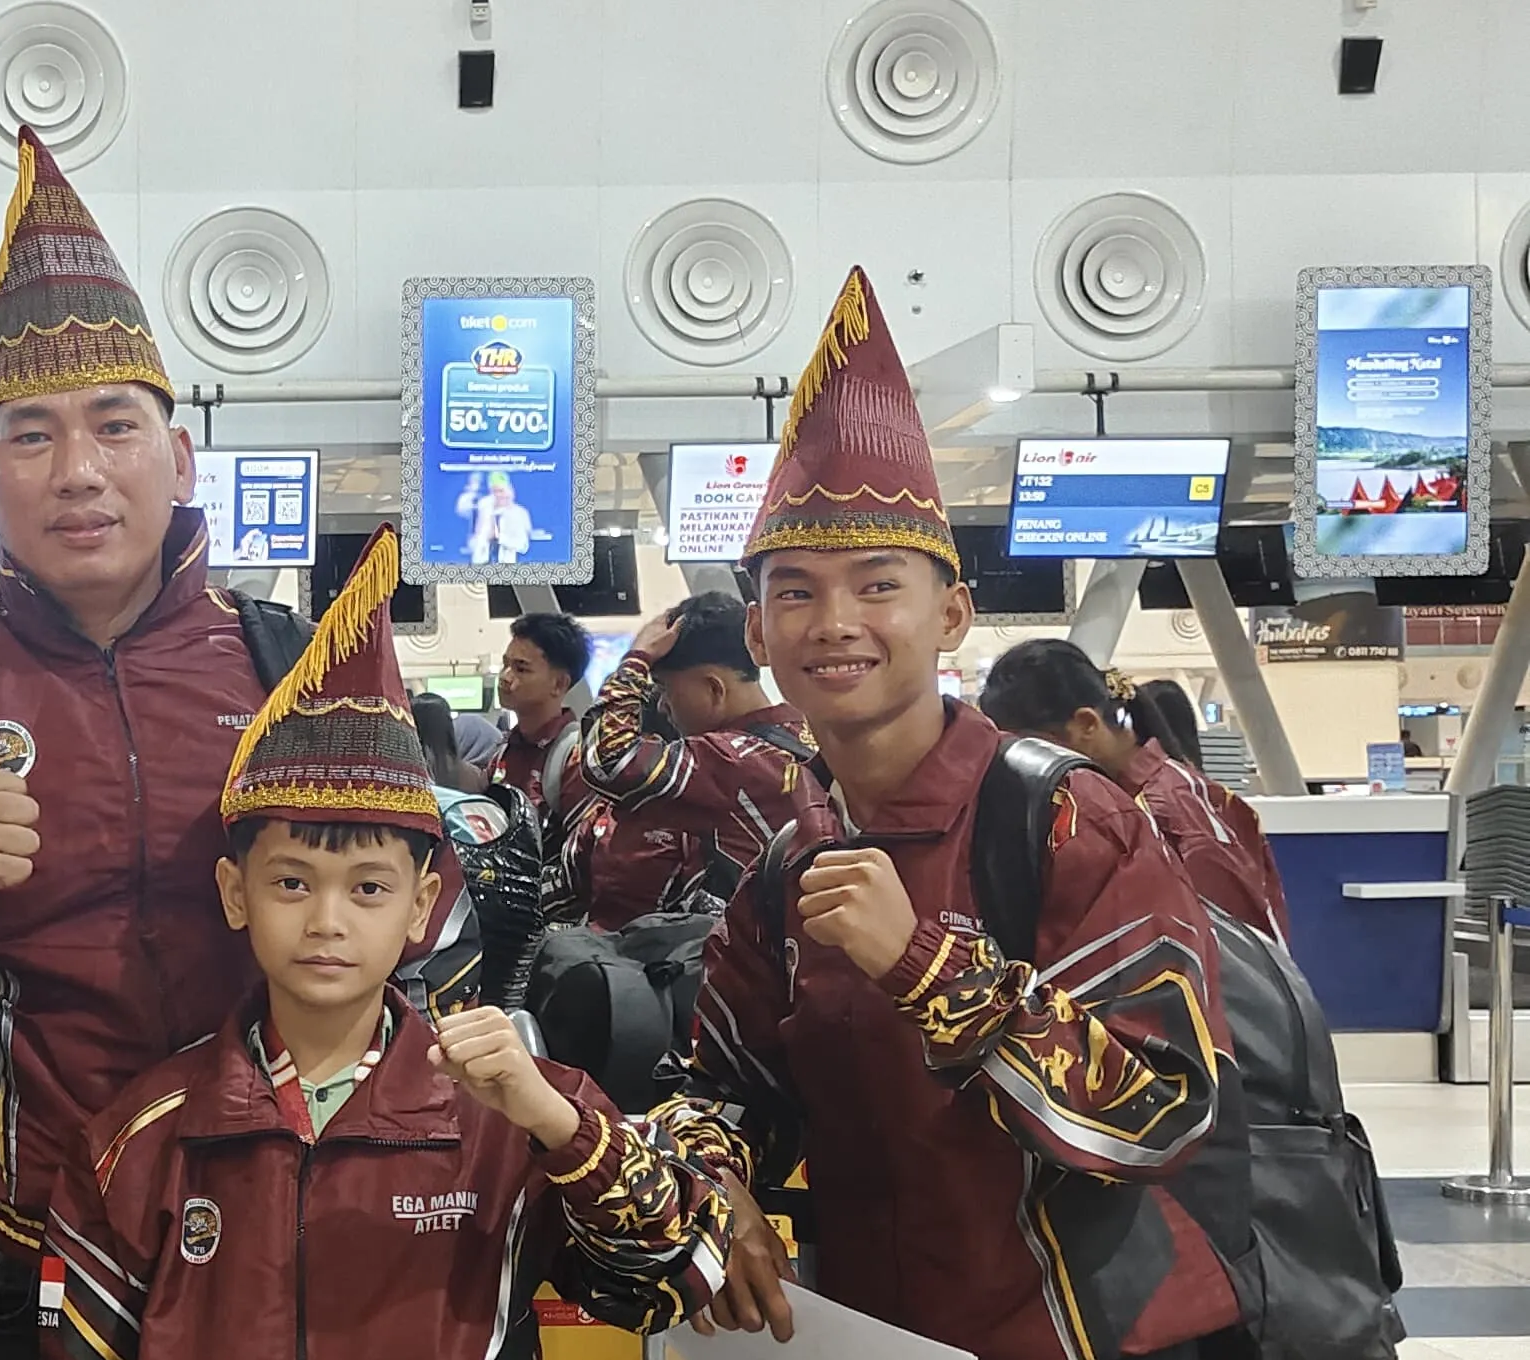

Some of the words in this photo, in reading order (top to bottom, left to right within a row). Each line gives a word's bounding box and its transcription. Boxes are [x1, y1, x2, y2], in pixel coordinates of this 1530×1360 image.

[1023, 453, 1055, 463] Lion
[1076, 452, 1097, 463] air
[706, 481, 731, 489] Lion
[694, 494, 733, 504] BOOK
[680, 511, 739, 521] PASTIKAN
[679, 533, 734, 543] CHECK-IN
[1065, 532, 1107, 543] ONLINE
[679, 544, 724, 553] ONLINE
[392, 1195, 426, 1213] EGA
[430, 1190, 479, 1210] MANIK
[413, 1213, 463, 1235] ATLET
